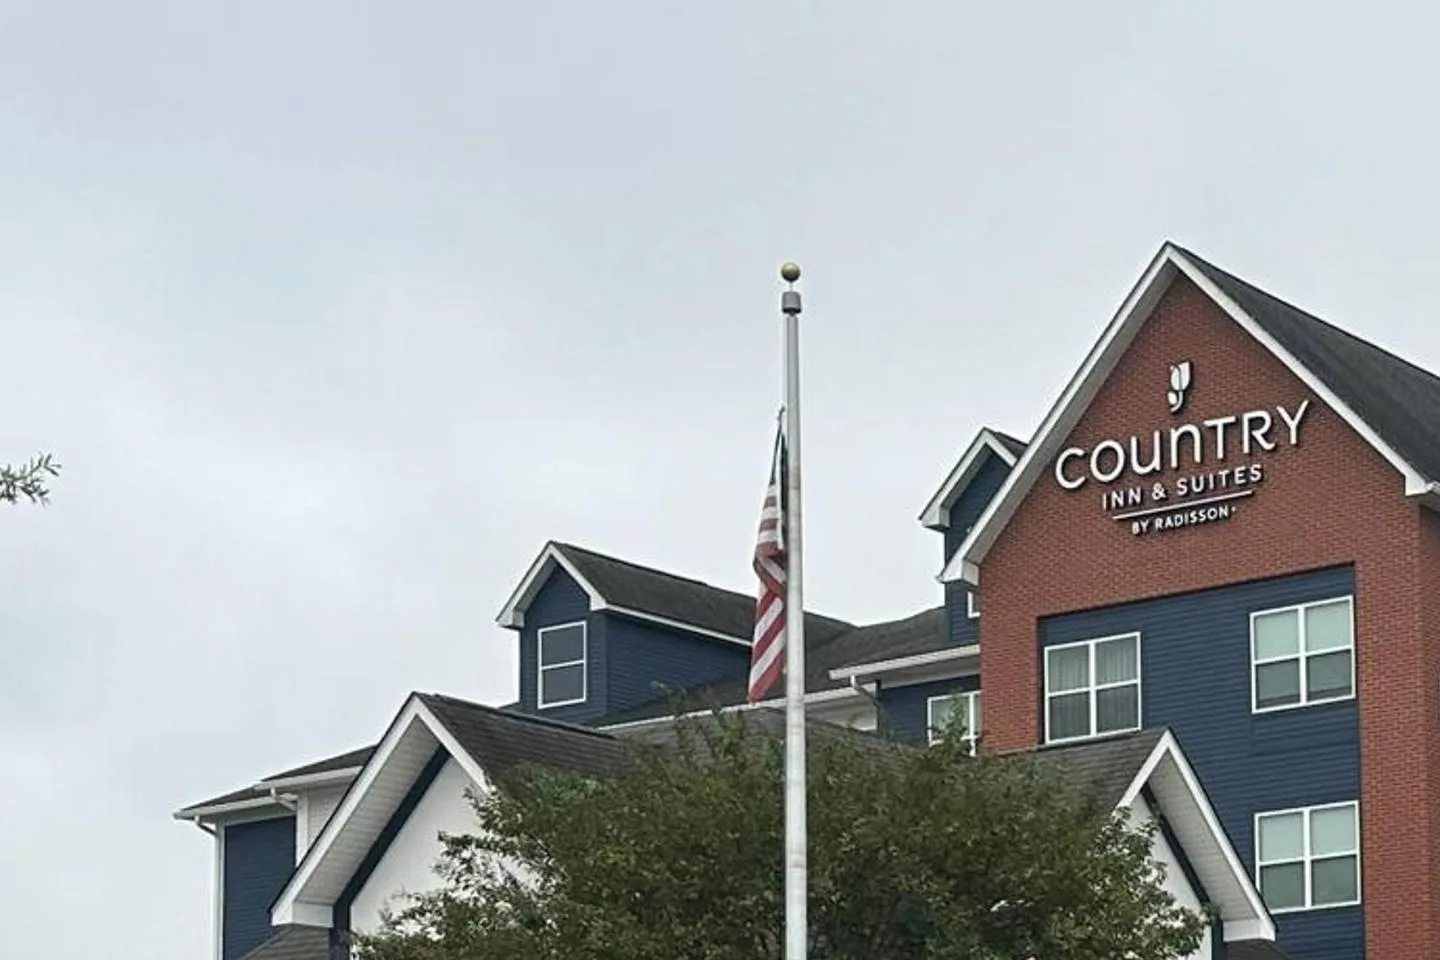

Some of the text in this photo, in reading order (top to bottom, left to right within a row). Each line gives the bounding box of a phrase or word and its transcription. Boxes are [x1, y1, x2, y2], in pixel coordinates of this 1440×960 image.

[1102, 464, 1263, 511] INN & SUITES
[1132, 506, 1229, 535] BY RADISSON
